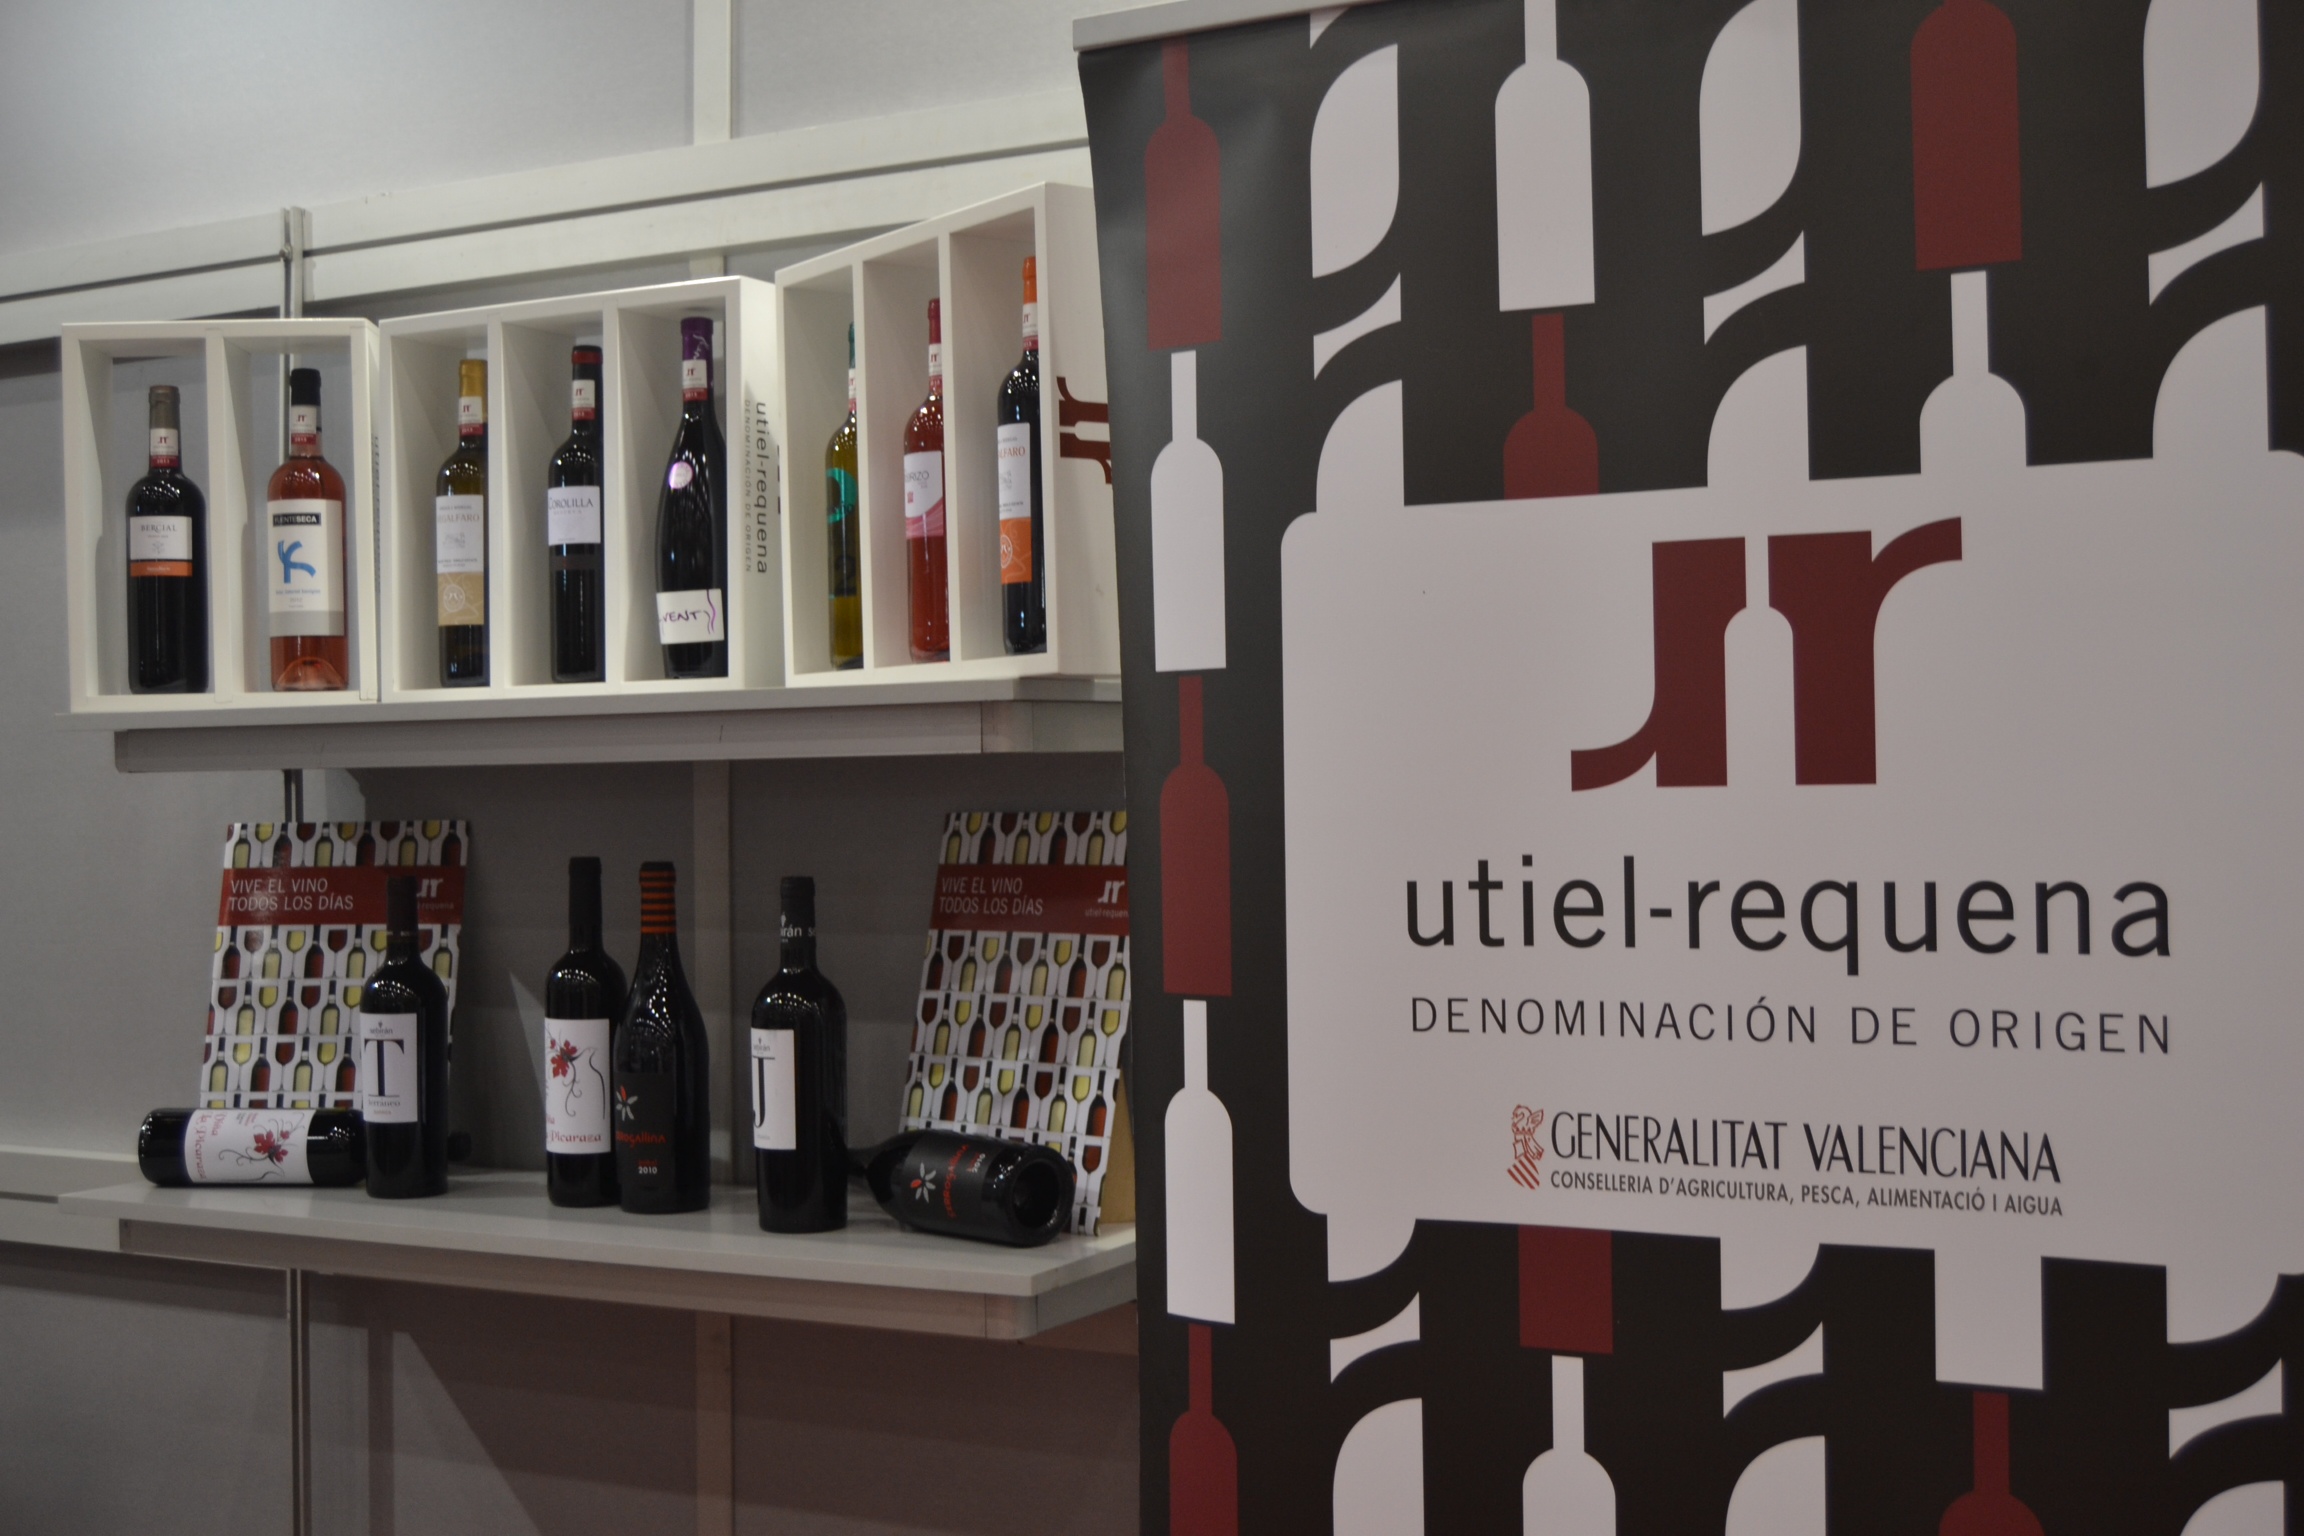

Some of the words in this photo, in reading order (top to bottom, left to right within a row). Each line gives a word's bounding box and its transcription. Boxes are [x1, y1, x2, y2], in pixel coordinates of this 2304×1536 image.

[754, 402, 770, 574] utiel-requena
[140, 523, 177, 533] BERCIAL
[229, 895, 279, 912] TODOS
[283, 895, 314, 911] LOS
[318, 891, 354, 911] DÍAS
[231, 877, 264, 894] VIVE
[268, 878, 286, 893] EL
[291, 877, 329, 893] VINO
[942, 876, 969, 894] VIVE
[971, 877, 987, 894] EL
[992, 877, 1023, 895] VINO
[939, 896, 979, 914] TODOS
[983, 897, 1009, 915] LOS
[1012, 894, 1044, 916] DÍAS
[1406, 854, 2171, 977] utiel-requena
[1412, 996, 1815, 1043] DENOMINACIÓN
[1851, 1006, 1918, 1046] DE
[1949, 1008, 2170, 1056] ORIGEN
[364, 1038, 405, 1097] T
[1551, 1110, 1788, 1170] GENERALITAT
[1803, 1122, 2062, 1184] VALENCIANA
[638, 1166, 658, 1175] 2010
[1550, 1170, 1654, 1195] CONSELLERIA
[1659, 1177, 1794, 1206] D'AGRICULTURA,
[1801, 1185, 1861, 1208] PESCA,
[1867, 1186, 1985, 1212] ALIMENTACIÓ
[2004, 1194, 2063, 1217] AIGUA
